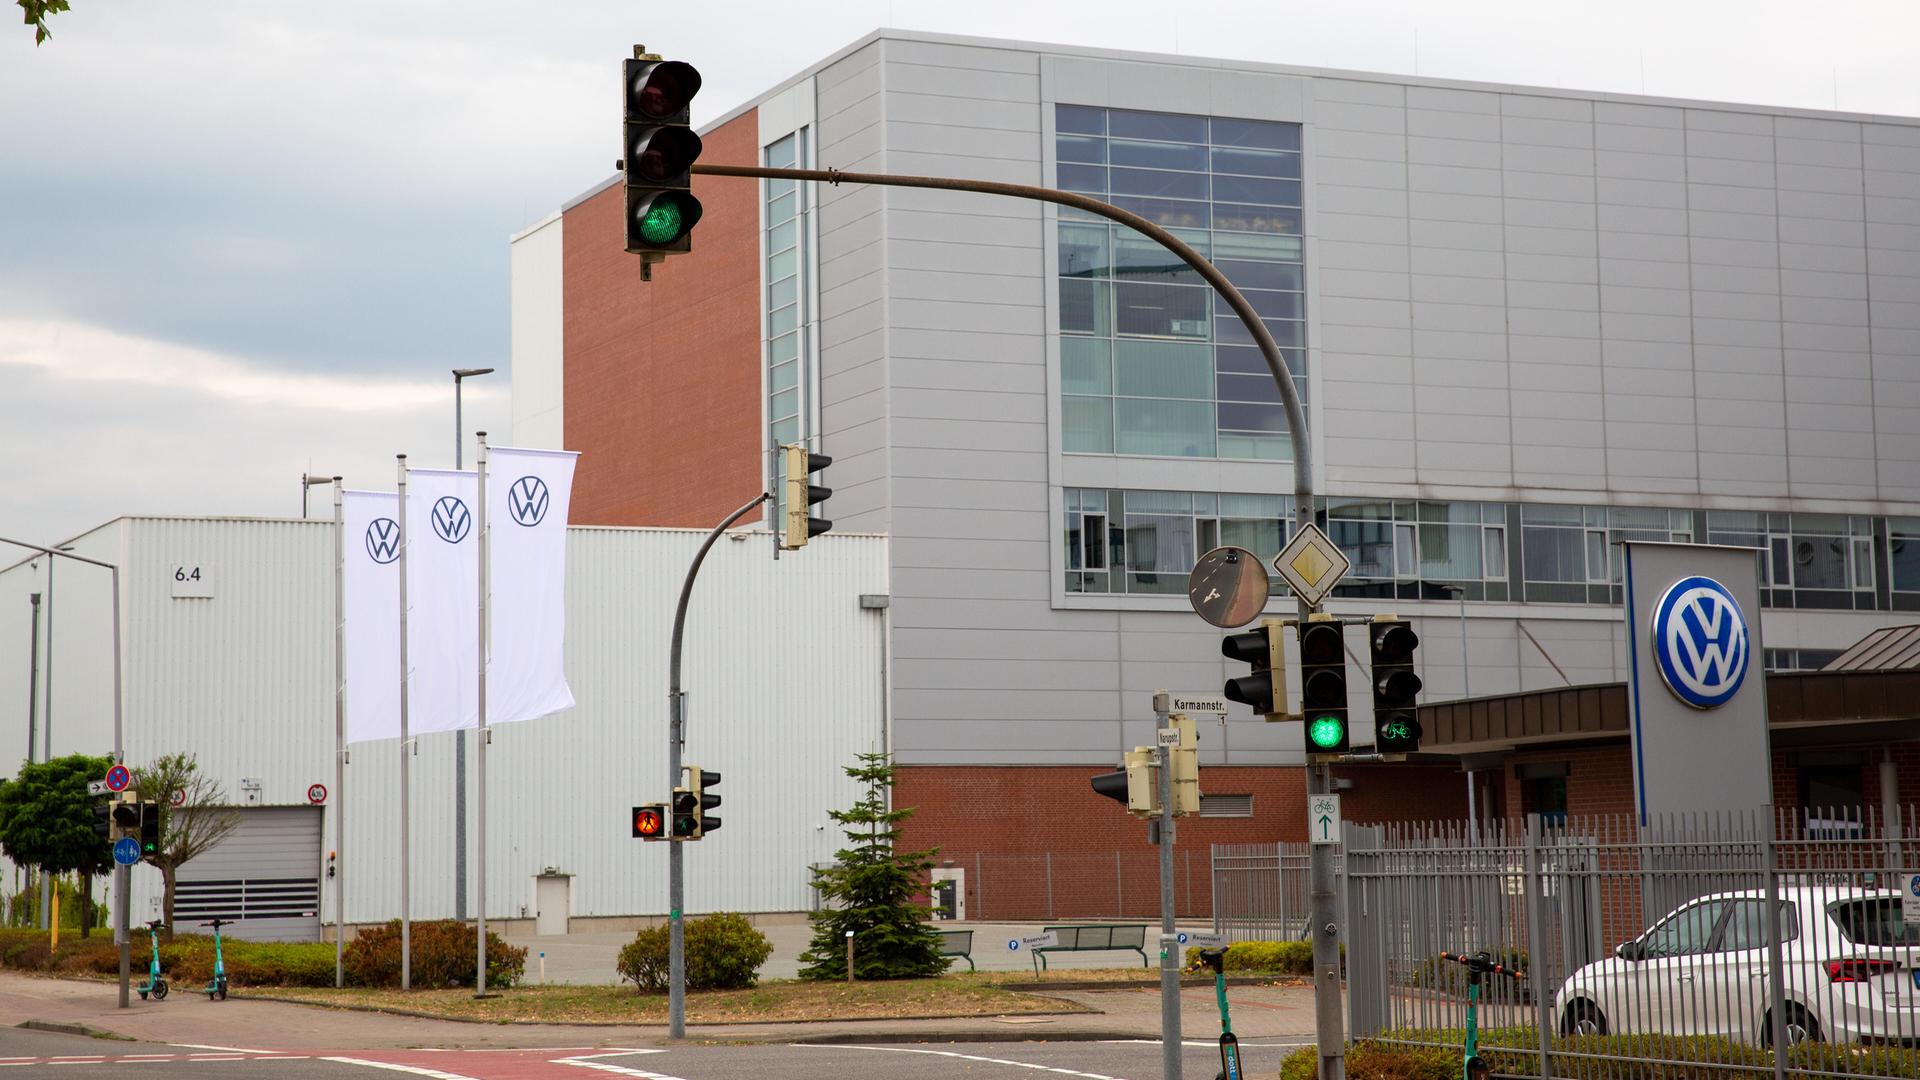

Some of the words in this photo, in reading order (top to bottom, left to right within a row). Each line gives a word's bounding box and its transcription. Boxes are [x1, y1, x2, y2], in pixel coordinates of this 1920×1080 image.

[509, 477, 549, 524] VW
[432, 497, 470, 543] VW
[367, 519, 401, 563] VW
[175, 566, 201, 581] 6.4
[1667, 588, 1745, 697] VW
[1174, 699, 1225, 711] Karmannstr.
[1220, 716, 1225, 725] 1
[1022, 935, 1050, 943] Reserviert
[1192, 934, 1221, 942] Reserviert
[1228, 1056, 1236, 1073] dott
